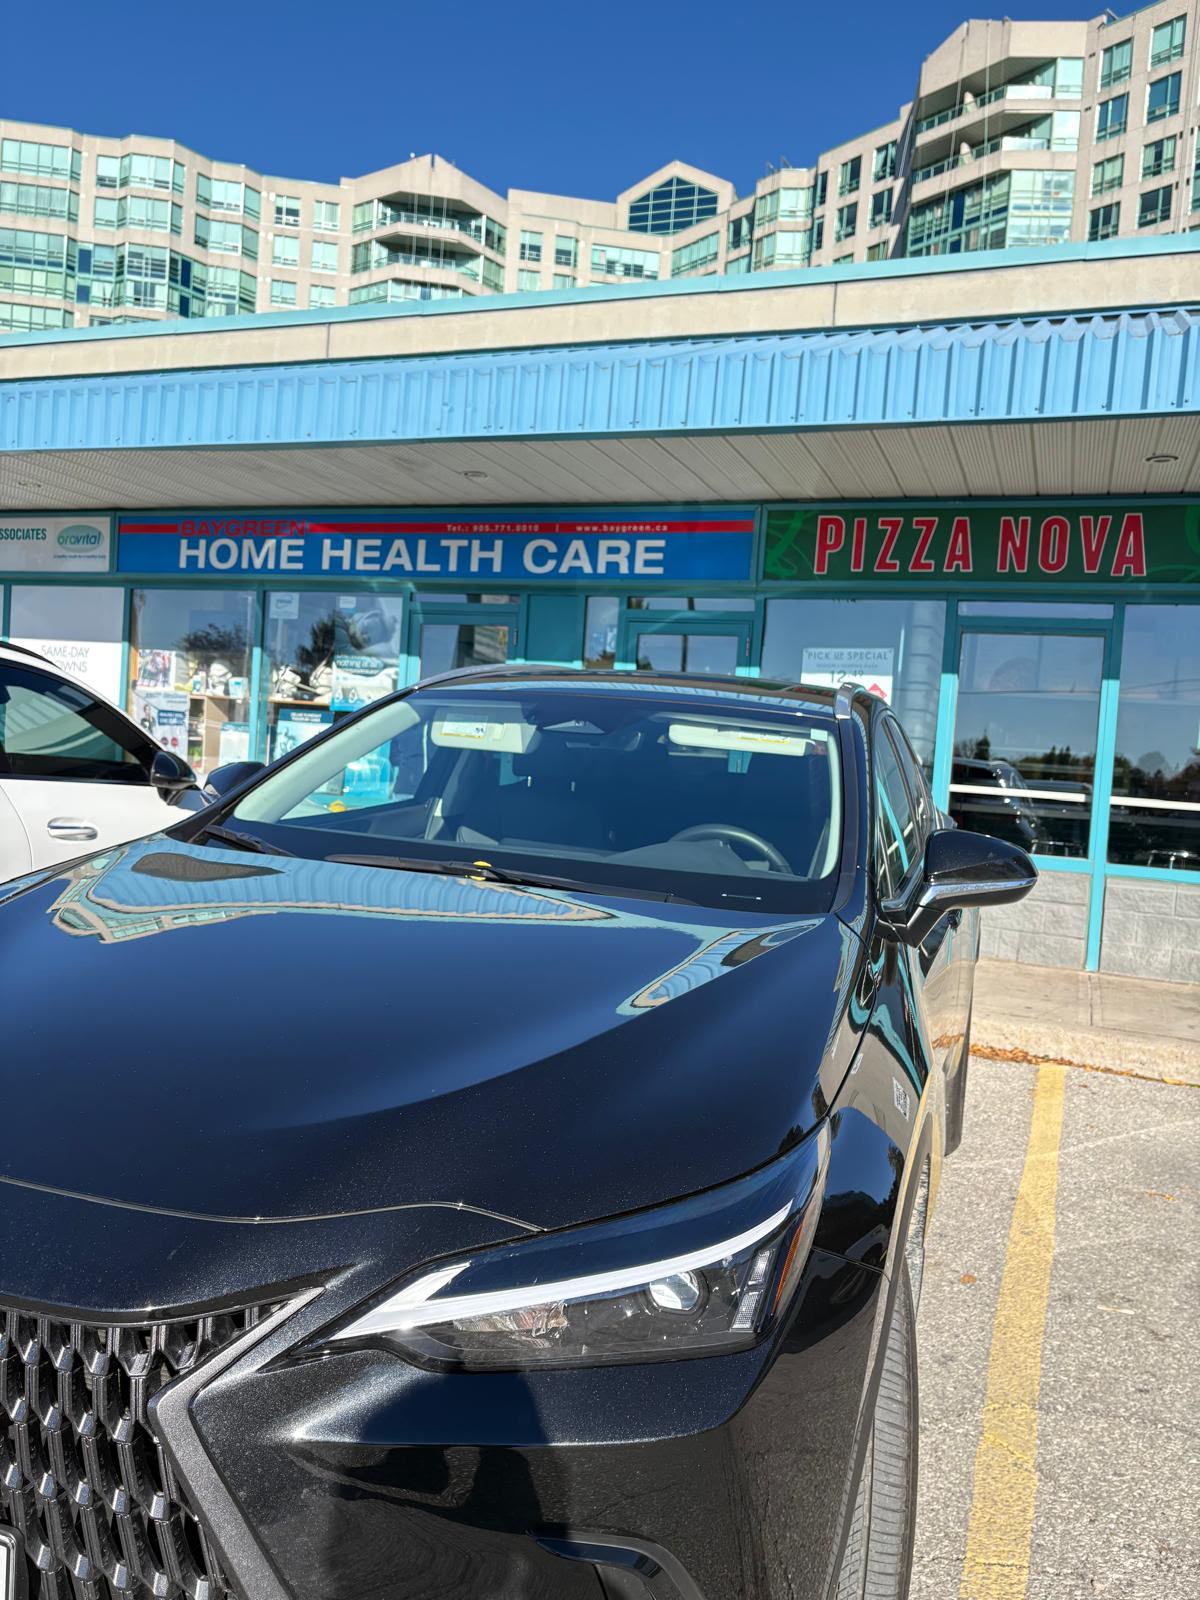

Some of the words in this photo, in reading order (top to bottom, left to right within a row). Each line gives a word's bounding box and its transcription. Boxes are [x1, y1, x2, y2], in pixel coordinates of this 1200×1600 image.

[180, 519, 306, 537] BAYGREEN
[575, 524, 668, 534] www.baygreen.ca
[813, 514, 973, 574] PIZZA
[996, 512, 1147, 577] NOVA
[178, 537, 305, 571] HOME
[321, 537, 504, 573] HEALTH
[522, 538, 667, 575] CARE
[41, 644, 90, 658] SAME-DAY
[807, 650, 830, 661] PICK
[847, 650, 888, 661] SPECIAL
